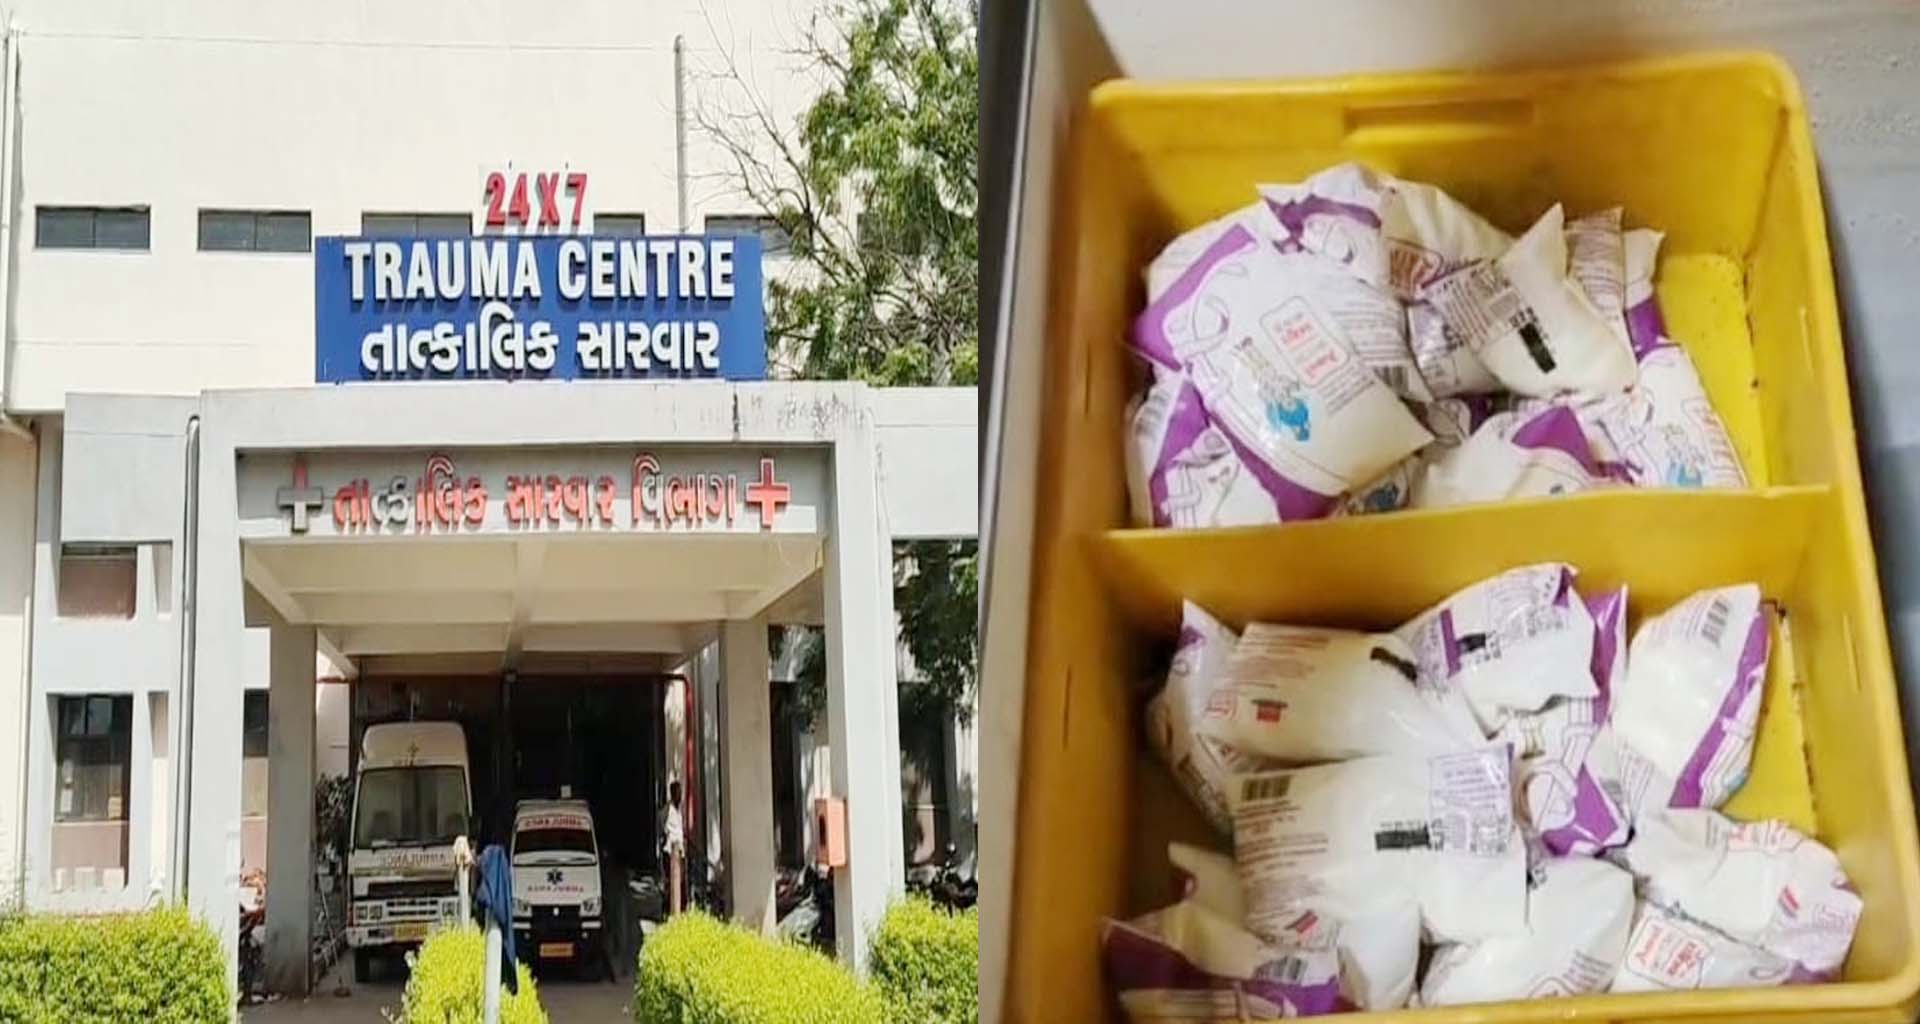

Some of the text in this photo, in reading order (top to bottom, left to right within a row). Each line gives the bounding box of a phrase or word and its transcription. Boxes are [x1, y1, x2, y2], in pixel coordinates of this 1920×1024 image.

[344, 240, 736, 300] TRAUMA CENTRE
[361, 301, 720, 371] તાત્કાલિક સારવાર
[333, 453, 738, 527] તાત્કાલિક સારવાર વિભાગ
